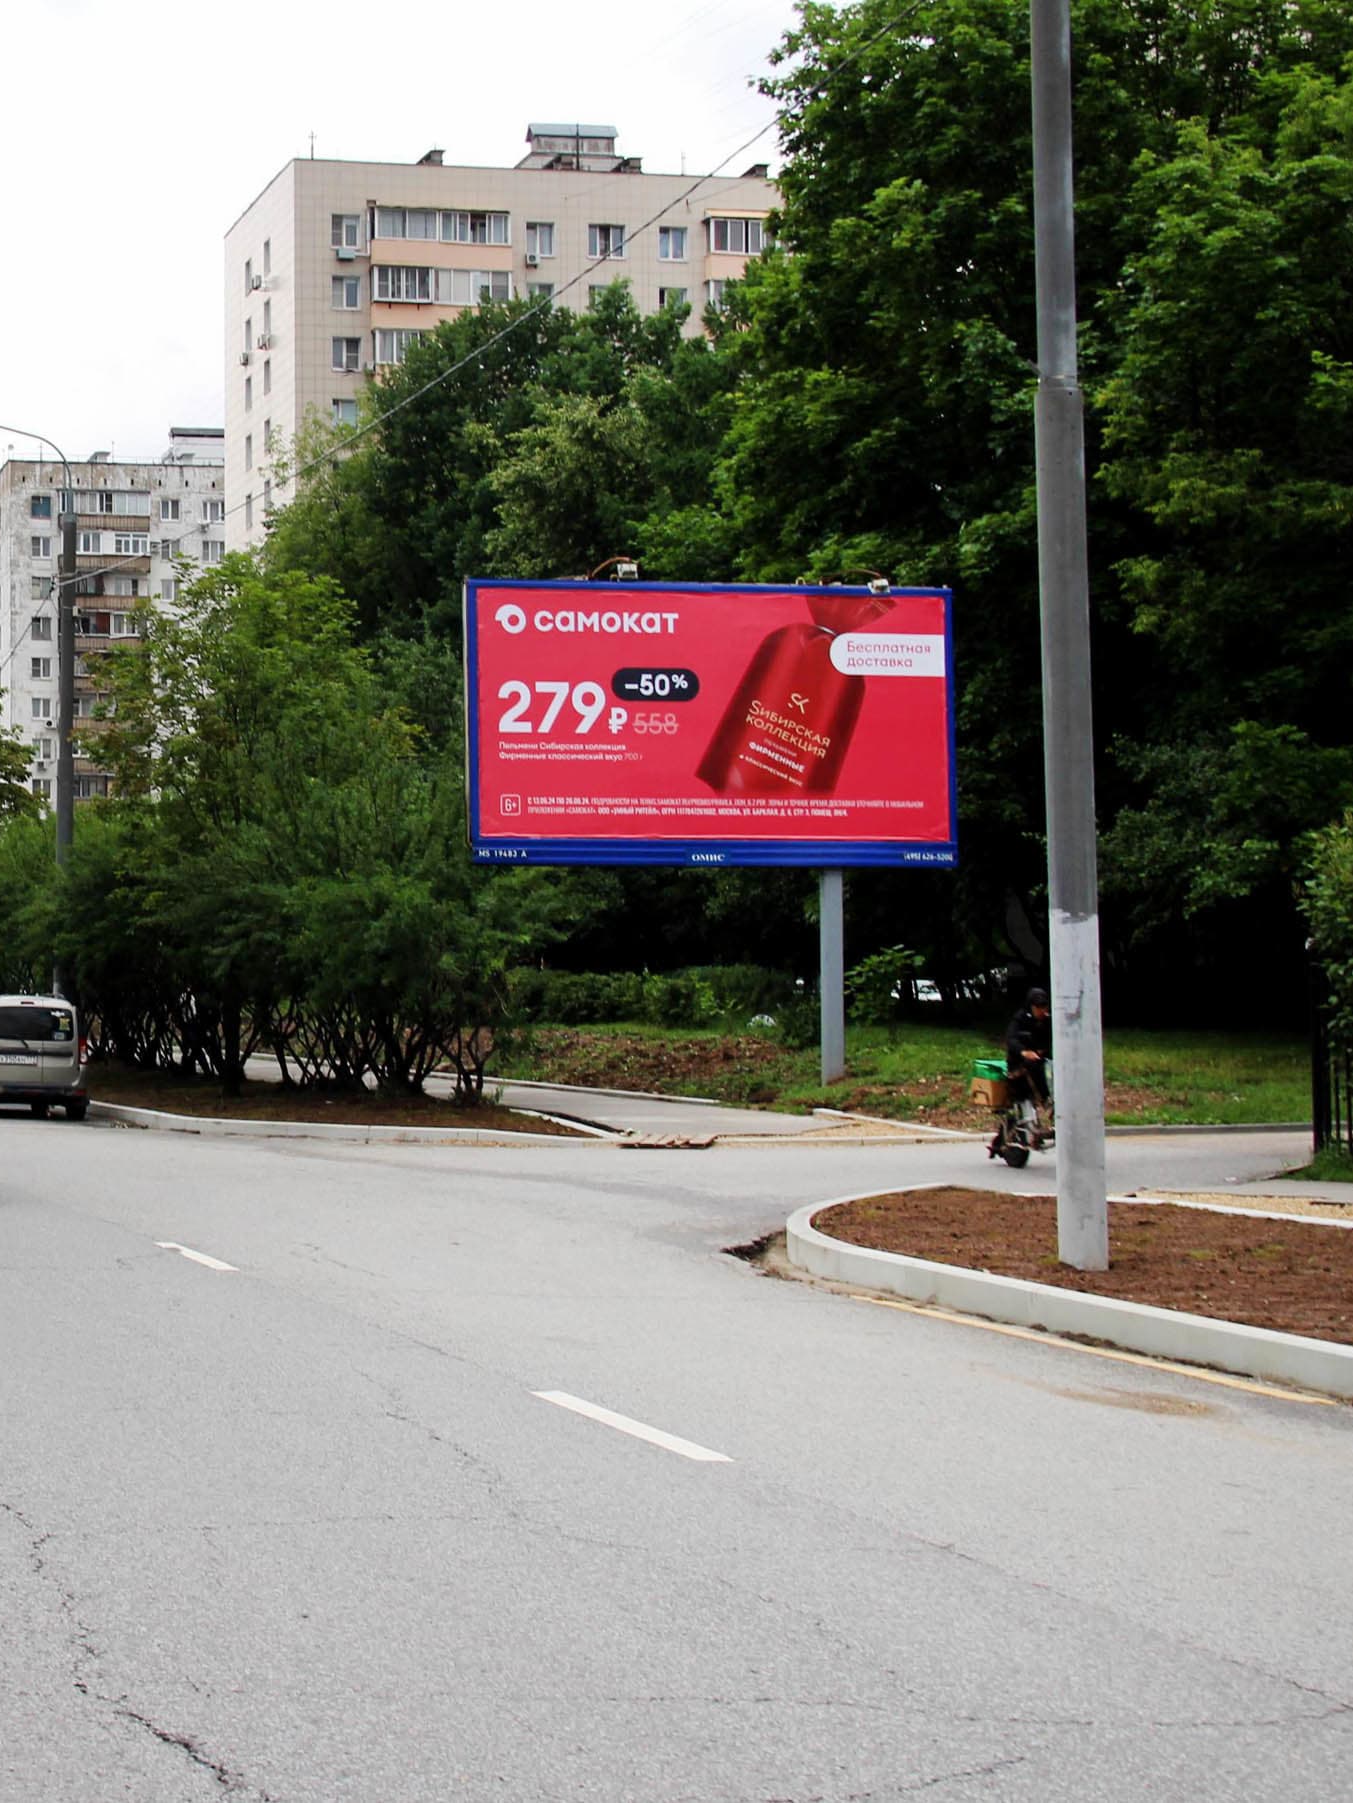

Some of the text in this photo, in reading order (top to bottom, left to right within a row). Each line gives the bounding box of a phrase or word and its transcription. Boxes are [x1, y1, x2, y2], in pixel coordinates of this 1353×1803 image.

[533, 610, 679, 633] самокат
[846, 641, 931, 654] Бесплатная
[846, 657, 913, 668] доставка
[632, 713, 680, 735] 558
[745, 714, 826, 759] КОЛЛЕКЦИЯ
[539, 741, 583, 751] Сибирская
[504, 798, 517, 811] 6+
